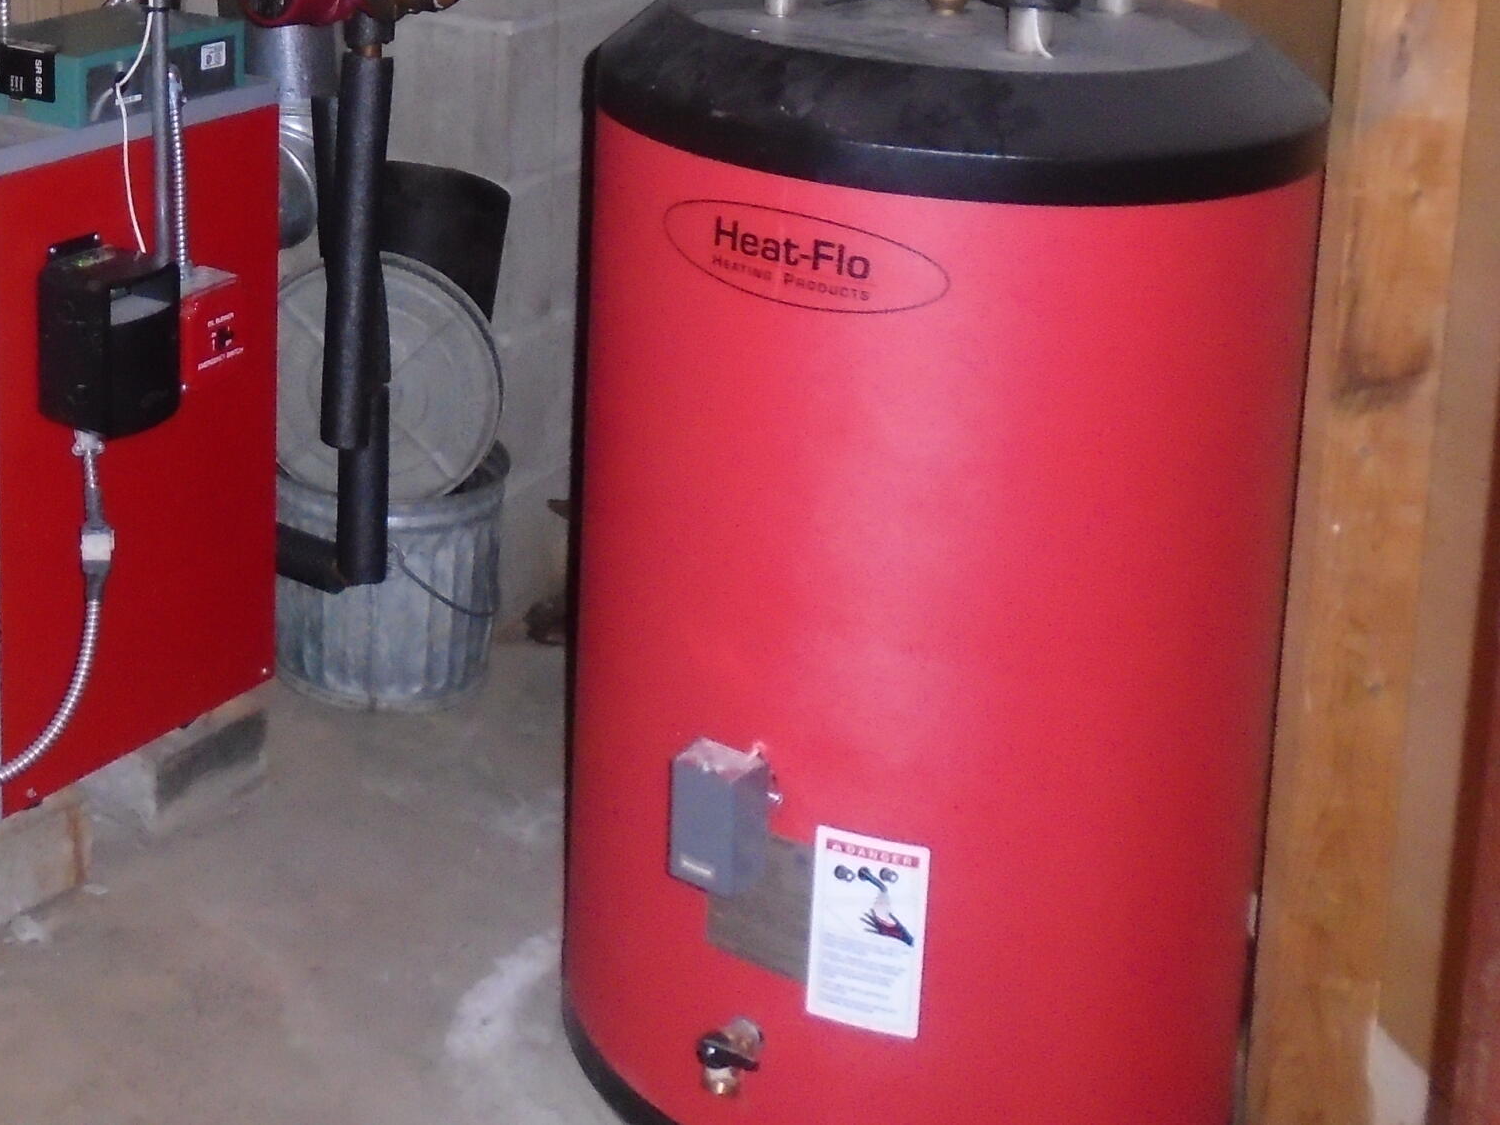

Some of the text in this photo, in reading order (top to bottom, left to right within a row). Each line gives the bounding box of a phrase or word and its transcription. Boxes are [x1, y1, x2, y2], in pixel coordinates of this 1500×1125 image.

[34, 59, 42, 74] SR
[713, 215, 871, 280] Heat-Flo
[783, 272, 871, 302] PRODUCTS
[844, 842, 913, 866] DANGER
